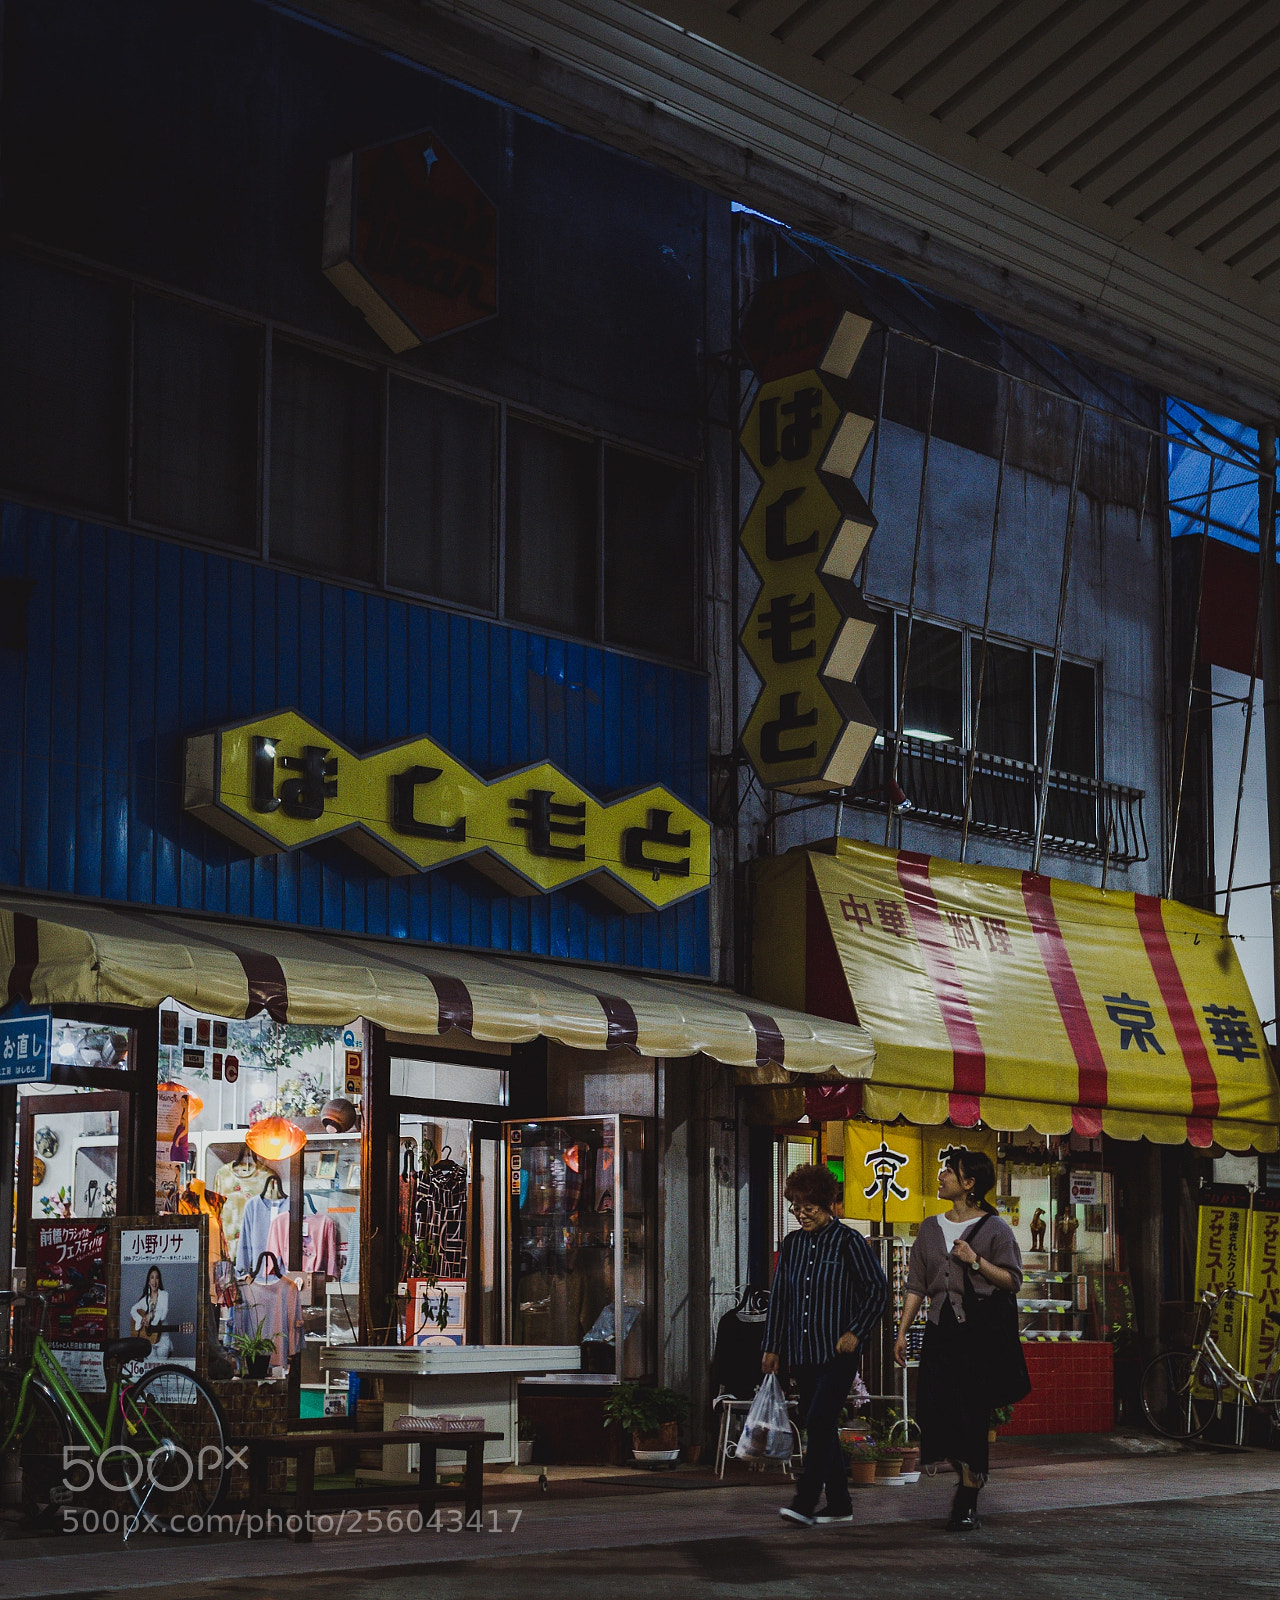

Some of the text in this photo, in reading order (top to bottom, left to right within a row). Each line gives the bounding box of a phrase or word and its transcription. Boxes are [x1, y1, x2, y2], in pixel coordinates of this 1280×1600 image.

[758, 387, 823, 764] はしもと
[250, 734, 692, 877] はしもと
[838, 892, 1017, 957] 中華料理
[3, 1033, 43, 1060] お直し
[1102, 992, 1261, 1063] 京華
[347, 1054, 360, 1075] P
[132, 1233, 184, 1255] 小野リサ
